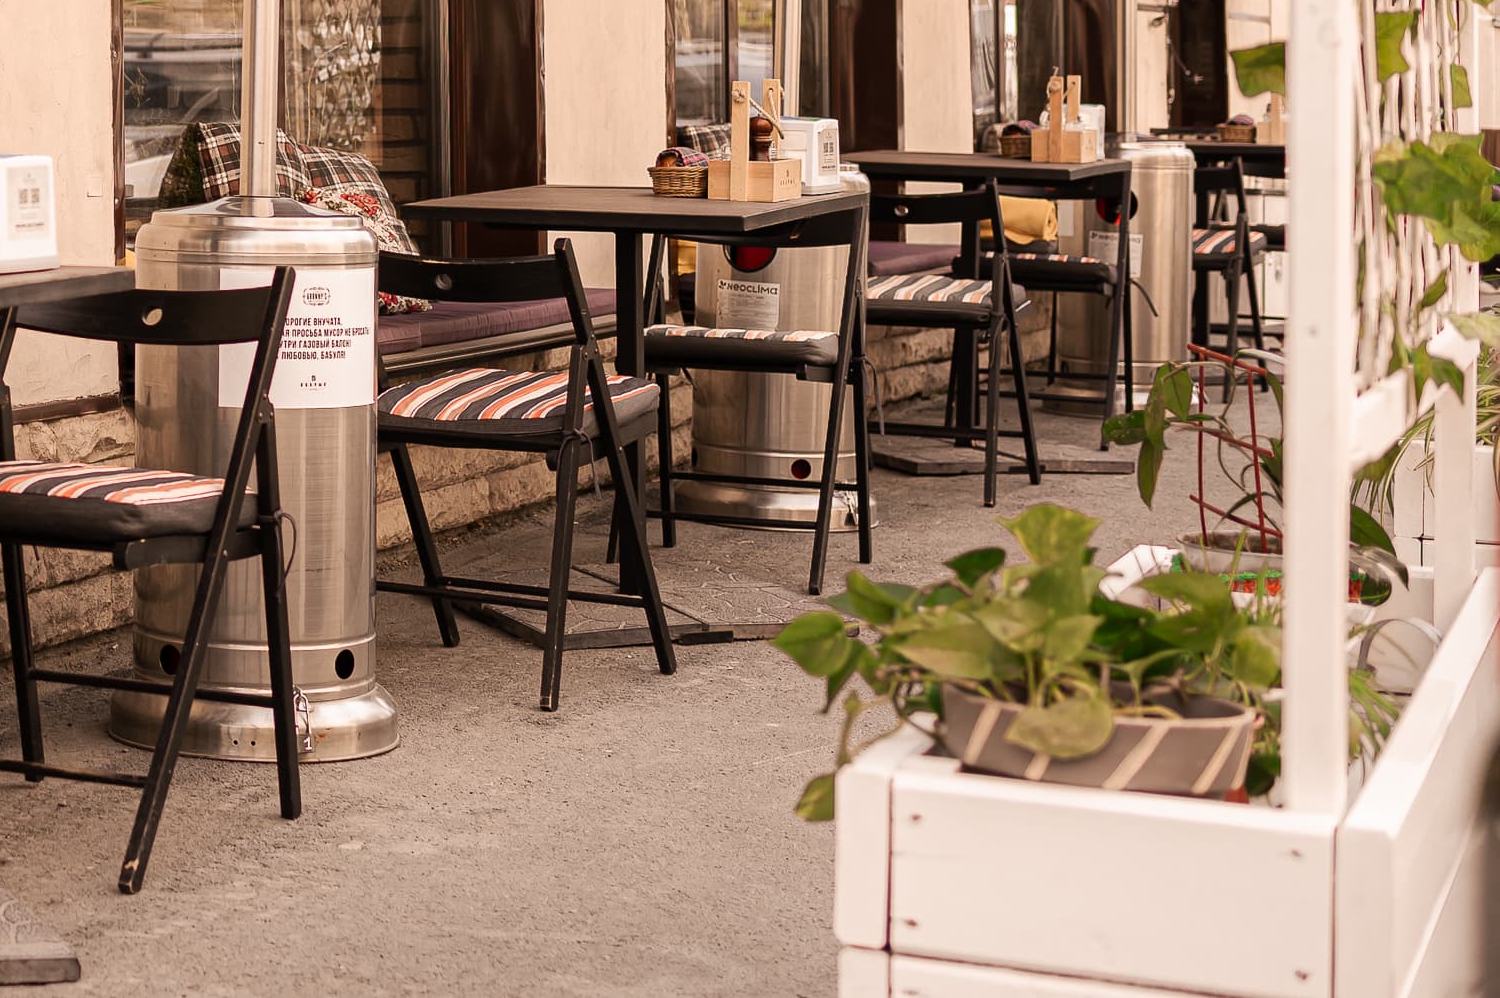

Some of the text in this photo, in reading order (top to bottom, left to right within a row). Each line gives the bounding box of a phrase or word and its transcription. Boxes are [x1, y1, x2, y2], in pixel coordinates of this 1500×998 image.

[285, 317, 311, 326] ОРОГИЕ
[291, 328, 322, 337] ПРОСЬБА
[323, 328, 343, 337] МУСОР
[280, 339, 296, 348] УТРИ
[298, 338, 330, 348] ГАЗОВЫЙ
[281, 351, 319, 360] ЛЮБОВЬЮ,
[303, 736, 313, 751] 1
